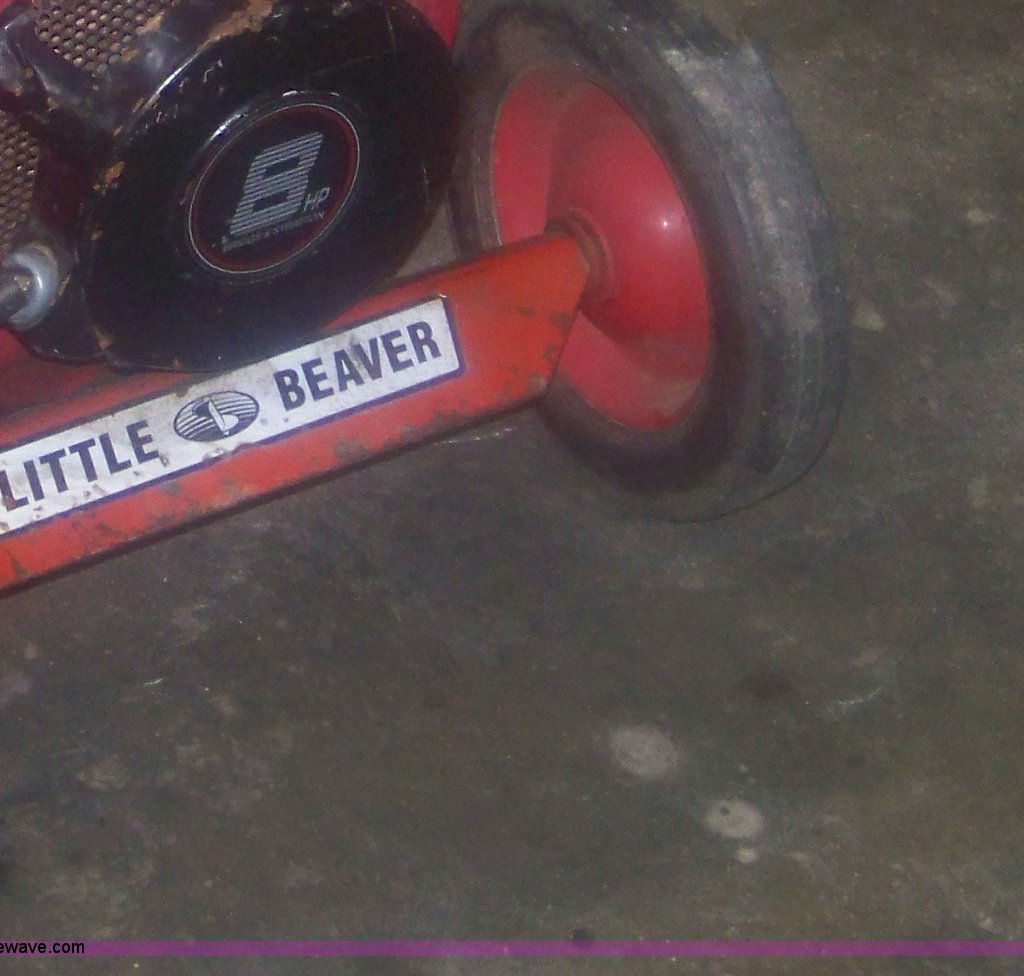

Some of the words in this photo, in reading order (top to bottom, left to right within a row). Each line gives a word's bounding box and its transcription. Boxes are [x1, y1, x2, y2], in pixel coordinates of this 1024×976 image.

[229, 130, 324, 235] 8
[302, 186, 331, 214] HP
[272, 320, 442, 412] BEAVER
